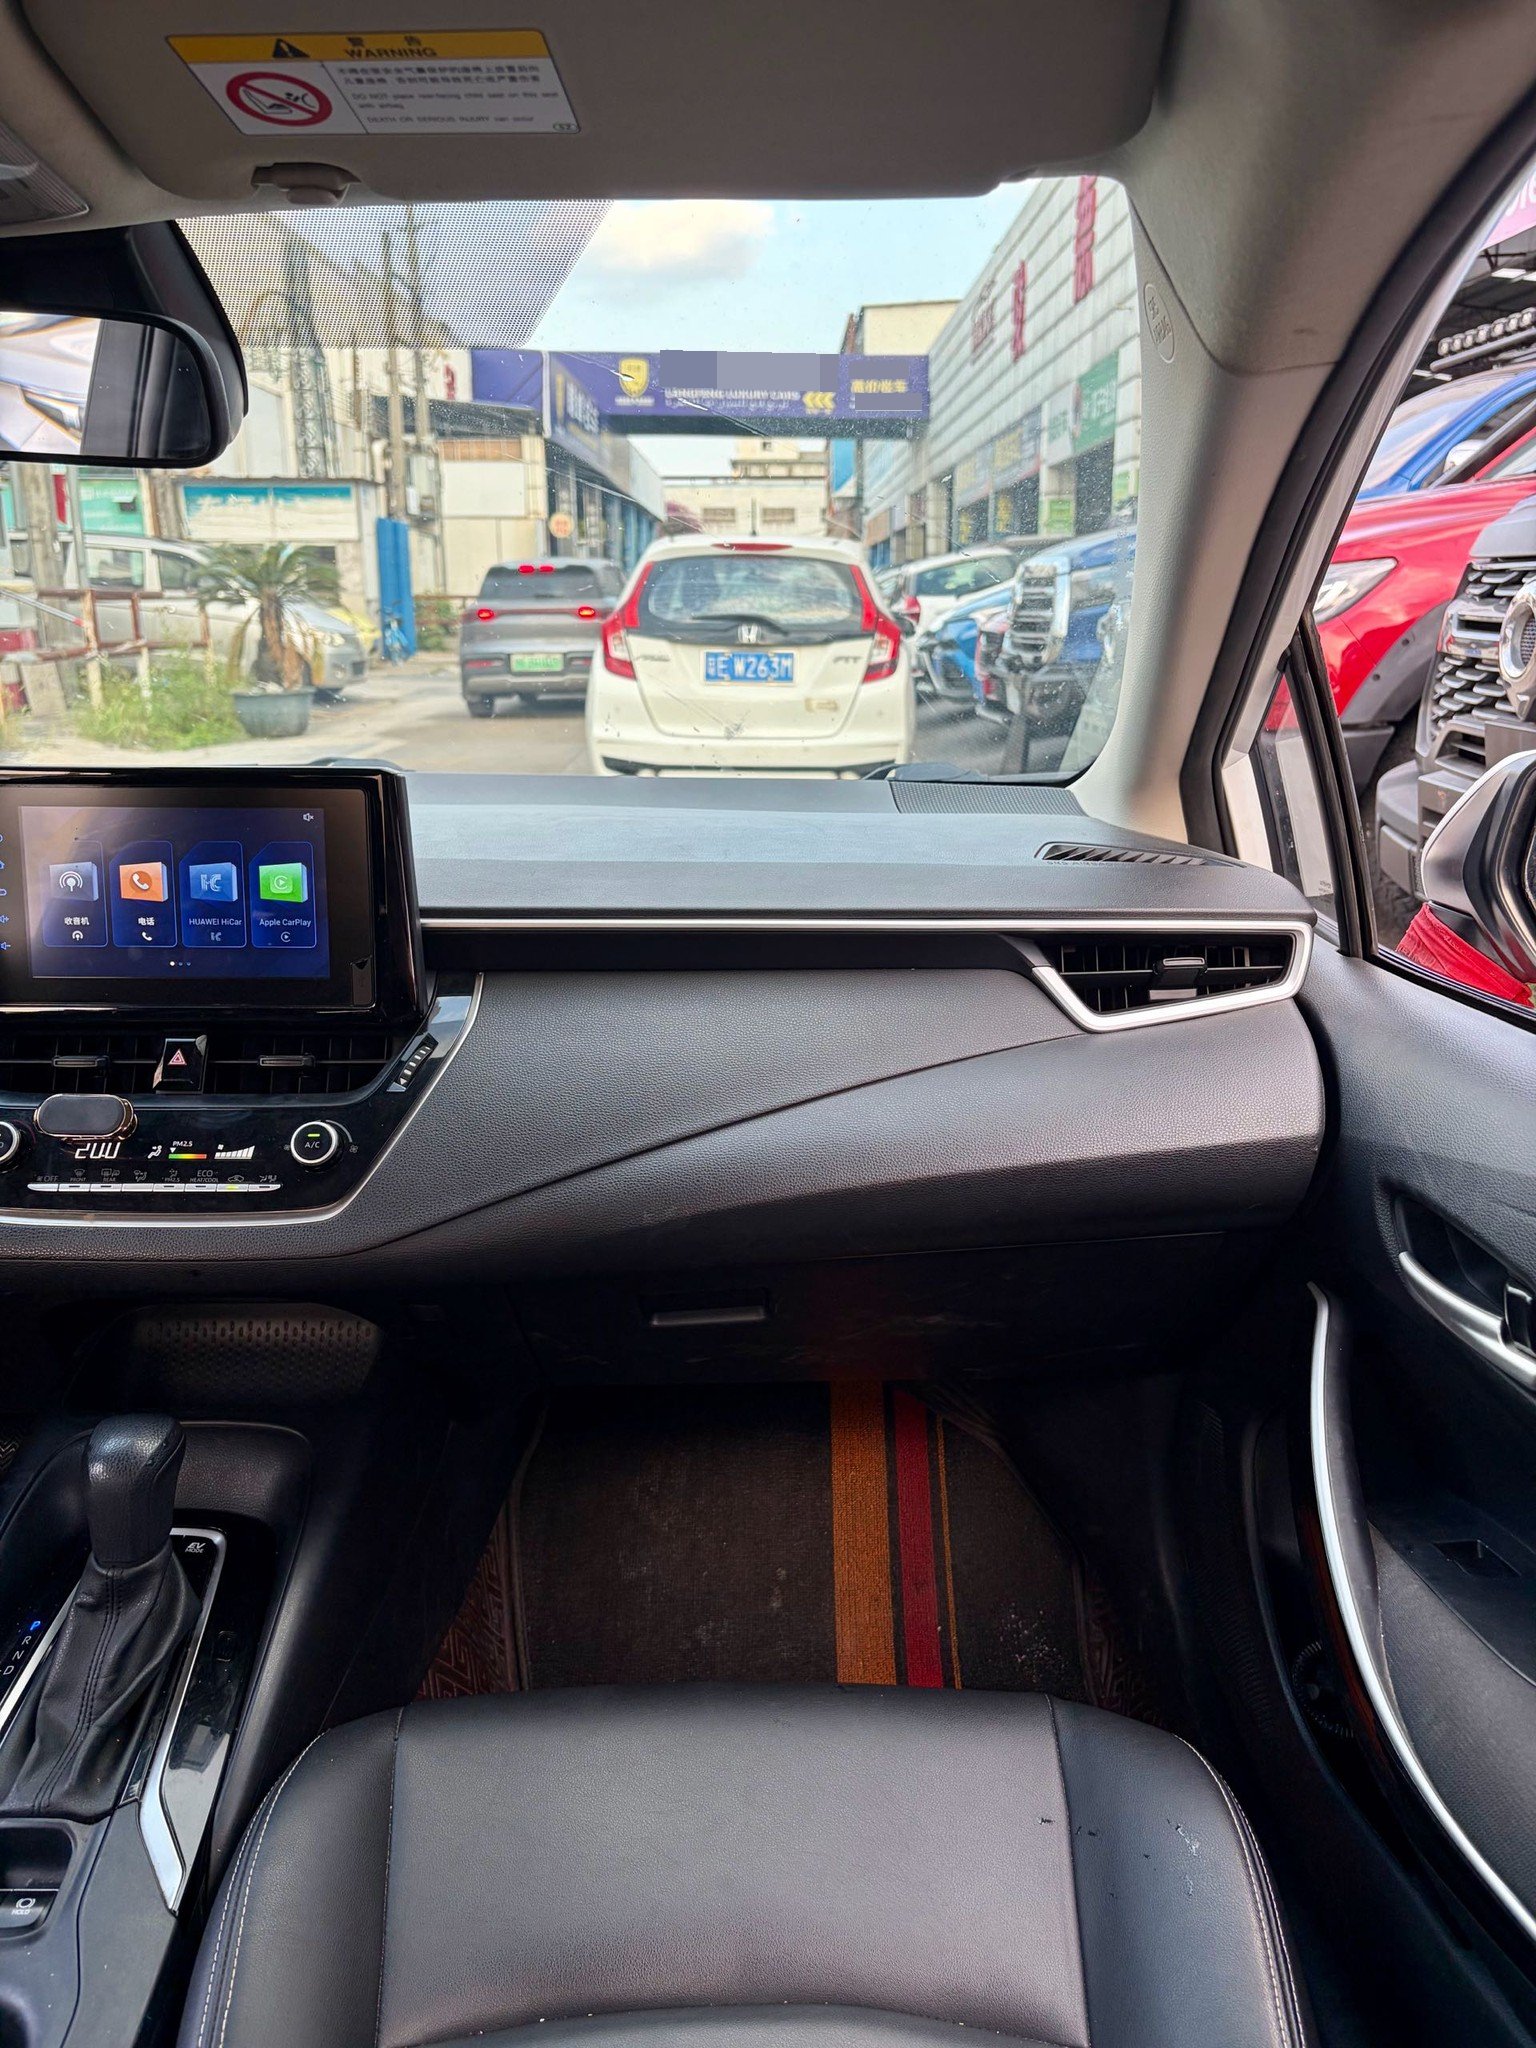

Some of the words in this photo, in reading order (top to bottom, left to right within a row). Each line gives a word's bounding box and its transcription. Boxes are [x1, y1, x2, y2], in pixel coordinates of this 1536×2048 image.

[344, 47, 437, 58] WARNING
[64, 916, 90, 926] 收音机
[138, 916, 156, 926] 电话
[189, 918, 220, 926] HUAWEI
[221, 918, 243, 926] HiCar
[259, 917, 280, 928] Apple
[281, 917, 312, 928] CarPlay
[172, 1140, 193, 1149] PM2.5
[304, 1141, 321, 1149] A/C
[196, 1169, 214, 1177] ECO
[43, 1175, 60, 1183] OFF
[30, 1620, 41, 1631] P
[21, 1635, 32, 1646] R
[12, 1650, 25, 1661] N
[3, 1665, 15, 1676] D
